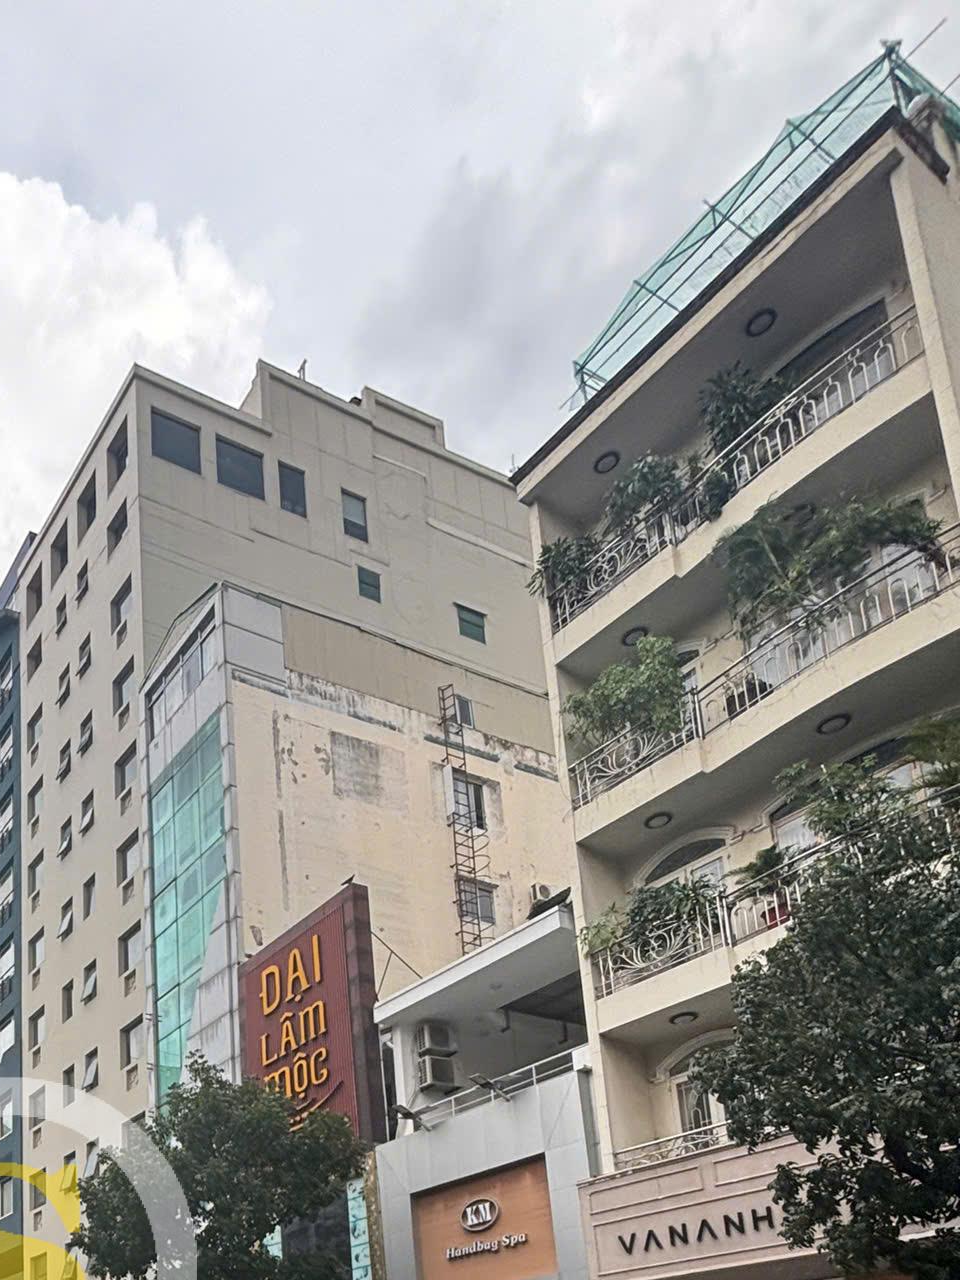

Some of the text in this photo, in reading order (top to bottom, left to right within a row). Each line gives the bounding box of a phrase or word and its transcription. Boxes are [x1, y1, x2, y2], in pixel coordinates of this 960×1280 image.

[259, 934, 322, 1017] ĐẠI
[466, 1202, 492, 1226] KM
[446, 1233, 527, 1259] Handbag Spa
